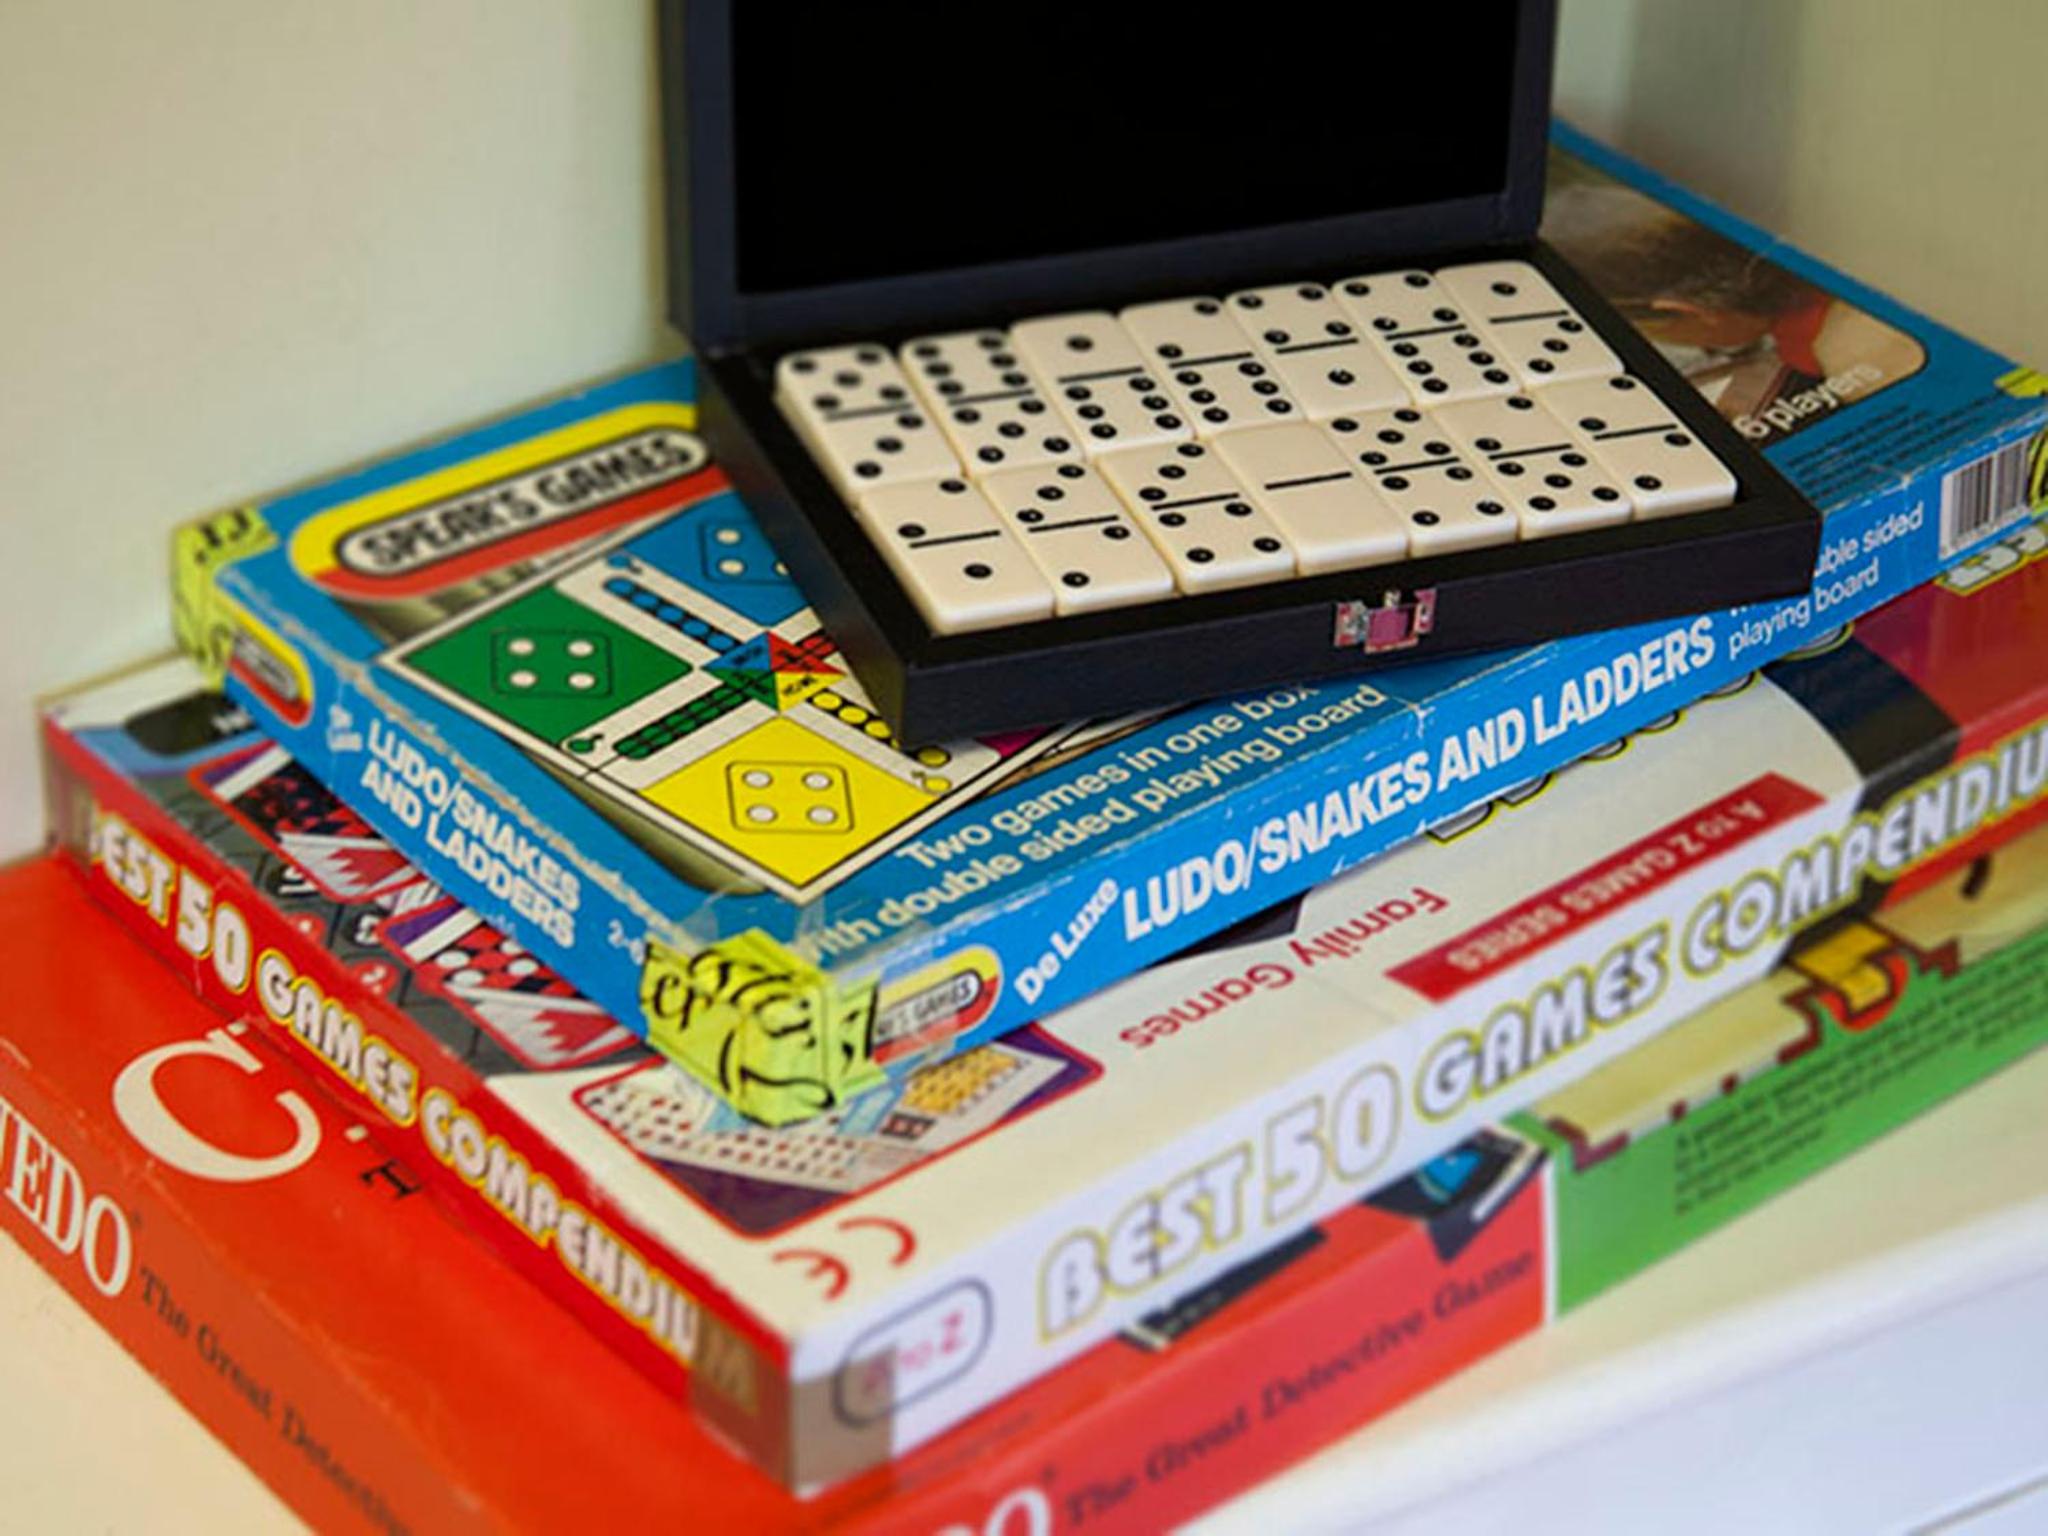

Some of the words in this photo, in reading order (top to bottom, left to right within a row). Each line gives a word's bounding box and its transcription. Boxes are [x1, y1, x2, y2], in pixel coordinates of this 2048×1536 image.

[535, 436, 691, 503] GAMES
[1764, 363, 1884, 431] players
[1862, 501, 1925, 552] sided
[1728, 598, 1811, 661] playing
[1815, 556, 1880, 614] board
[360, 760, 423, 829] AND
[425, 812, 575, 950] LADDERS
[367, 718, 582, 913] LUDO/SNAKES
[877, 853, 1024, 928] double
[1019, 797, 1139, 861] sided
[1131, 738, 1284, 814] playing
[1263, 683, 1387, 747] board
[895, 823, 993, 868] Two
[991, 764, 1131, 836] games
[1118, 750, 1172, 773] in
[1166, 713, 1244, 754] one
[1013, 952, 1062, 1006] De
[1050, 877, 1120, 961] Luxe
[1122, 750, 1432, 942] LUDO/SNAKES
[1437, 707, 1527, 793] AND
[1532, 614, 1716, 746] LADDERS
[1730, 797, 1767, 822] A
[1288, 886, 1450, 968] Family
[1446, 903, 1569, 972] SERIES
[1559, 848, 1678, 913] GAMES
[91, 811, 177, 928] EST
[175, 864, 253, 995] 50
[257, 947, 420, 1129] GAMES
[1036, 1138, 1254, 1345] BEST
[1262, 1061, 1403, 1228] 50
[1414, 918, 1673, 1124] GAMES
[1680, 715, 2048, 979] COMPENDIU
[1118, 962, 1296, 1048] Games
[0, 1095, 132, 1298] EDO
[139, 1265, 190, 1340] The
[196, 1322, 275, 1421] Great
[1064, 1472, 1137, 1528] The
[1144, 1407, 1252, 1487] Great
[1259, 1312, 1425, 1422] Detective
[1432, 1250, 1535, 1319] Game
